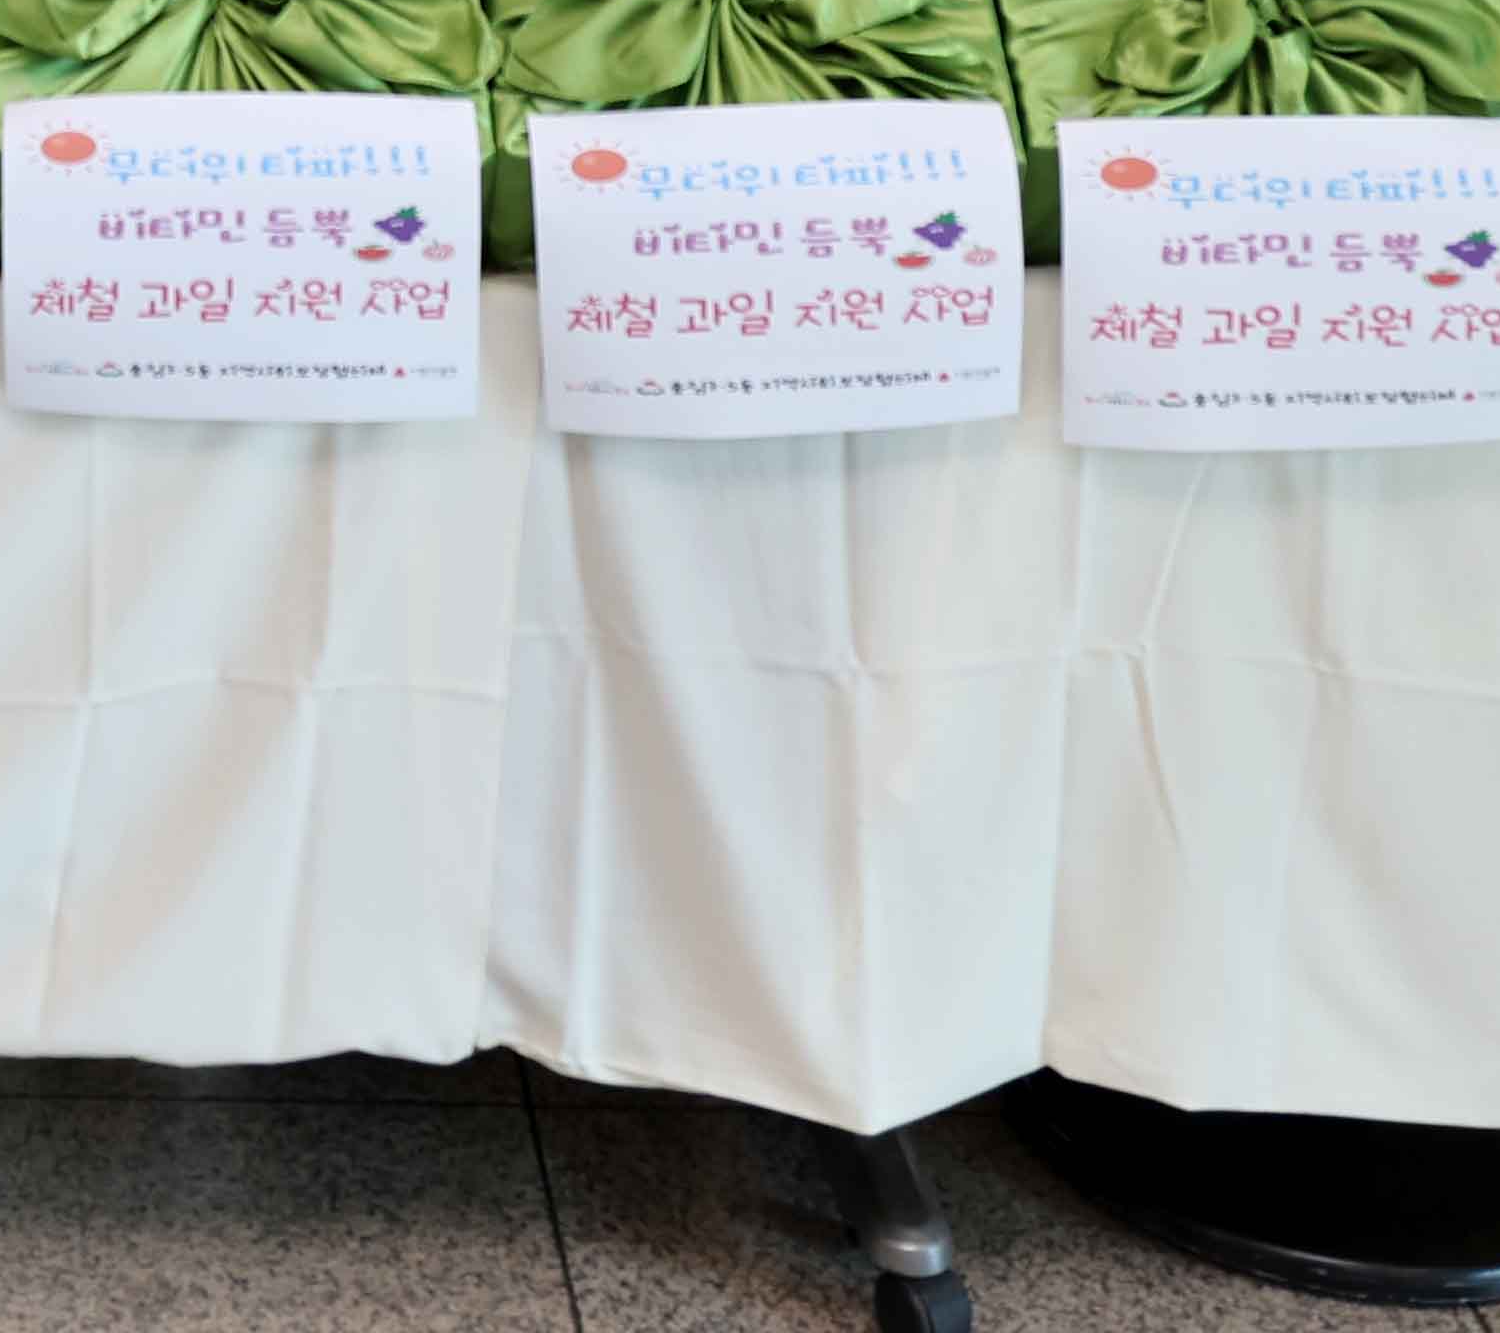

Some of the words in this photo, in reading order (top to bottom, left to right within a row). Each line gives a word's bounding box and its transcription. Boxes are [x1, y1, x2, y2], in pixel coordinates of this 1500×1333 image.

[106, 146, 250, 184] 무더위
[259, 146, 427, 179] 타파!!!
[637, 162, 782, 200] 무더위
[792, 149, 964, 185] 타파!!!
[1168, 173, 1313, 209] 무더위
[1326, 169, 1496, 202] 타파!!!
[96, 210, 247, 244] 비타민
[631, 220, 786, 256] 비타민
[1159, 232, 1314, 268] 비타민
[33, 275, 122, 322] 제철
[140, 275, 236, 324] 과일
[256, 278, 345, 323] 지원
[363, 279, 454, 321] 사업
[569, 292, 659, 339] 제철
[677, 290, 775, 337] 과일
[795, 286, 886, 332] 지원
[901, 288, 997, 327] 사업
[1092, 302, 1185, 350] 제철
[1200, 301, 1303, 350] 과일
[1322, 302, 1415, 348] 지원
